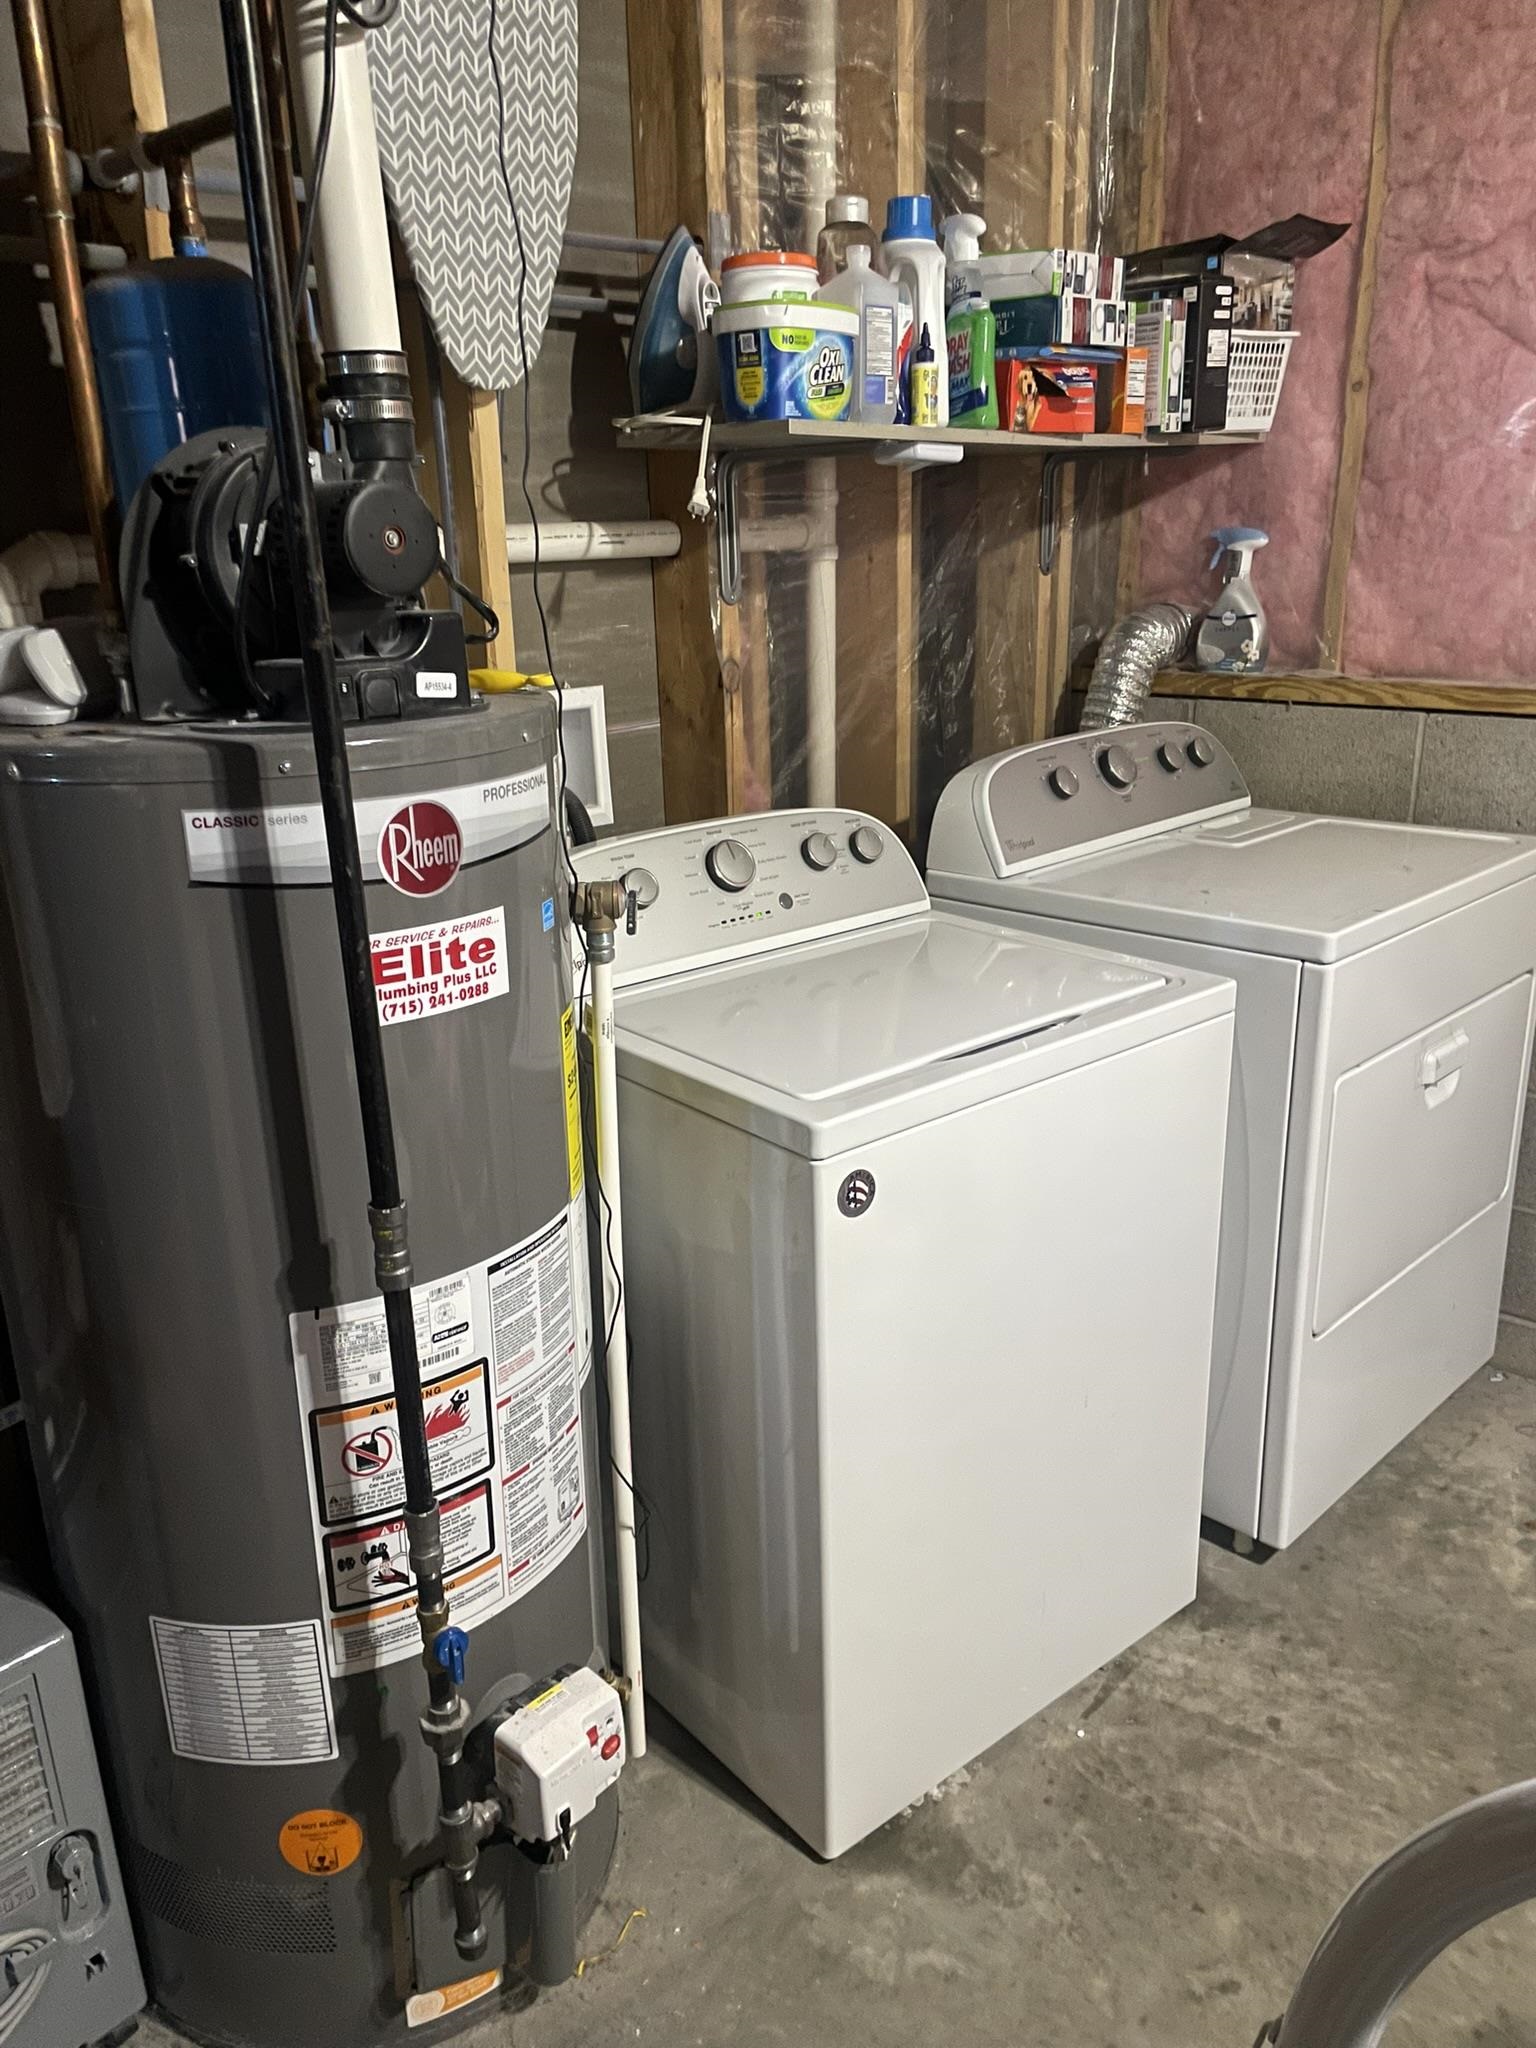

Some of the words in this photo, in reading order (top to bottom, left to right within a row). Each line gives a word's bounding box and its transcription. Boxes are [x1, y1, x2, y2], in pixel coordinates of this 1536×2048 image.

[820, 346, 841, 367] OXI
[809, 363, 845, 386] CLEAN
[483, 773, 546, 802] PROFESSIONAL
[191, 815, 259, 829] CLASSIC
[267, 812, 308, 826] series
[388, 805, 459, 882] Rheem
[385, 930, 435, 948] SERVICE
[438, 928, 448, 938] &
[452, 916, 500, 935] REPAIRS...
[370, 936, 496, 986] Elite
[378, 980, 439, 1001] lumbing
[443, 972, 472, 988] Plus
[475, 962, 497, 980] LLC
[382, 998, 424, 1022] (715)
[428, 981, 489, 1009] 241-0288
